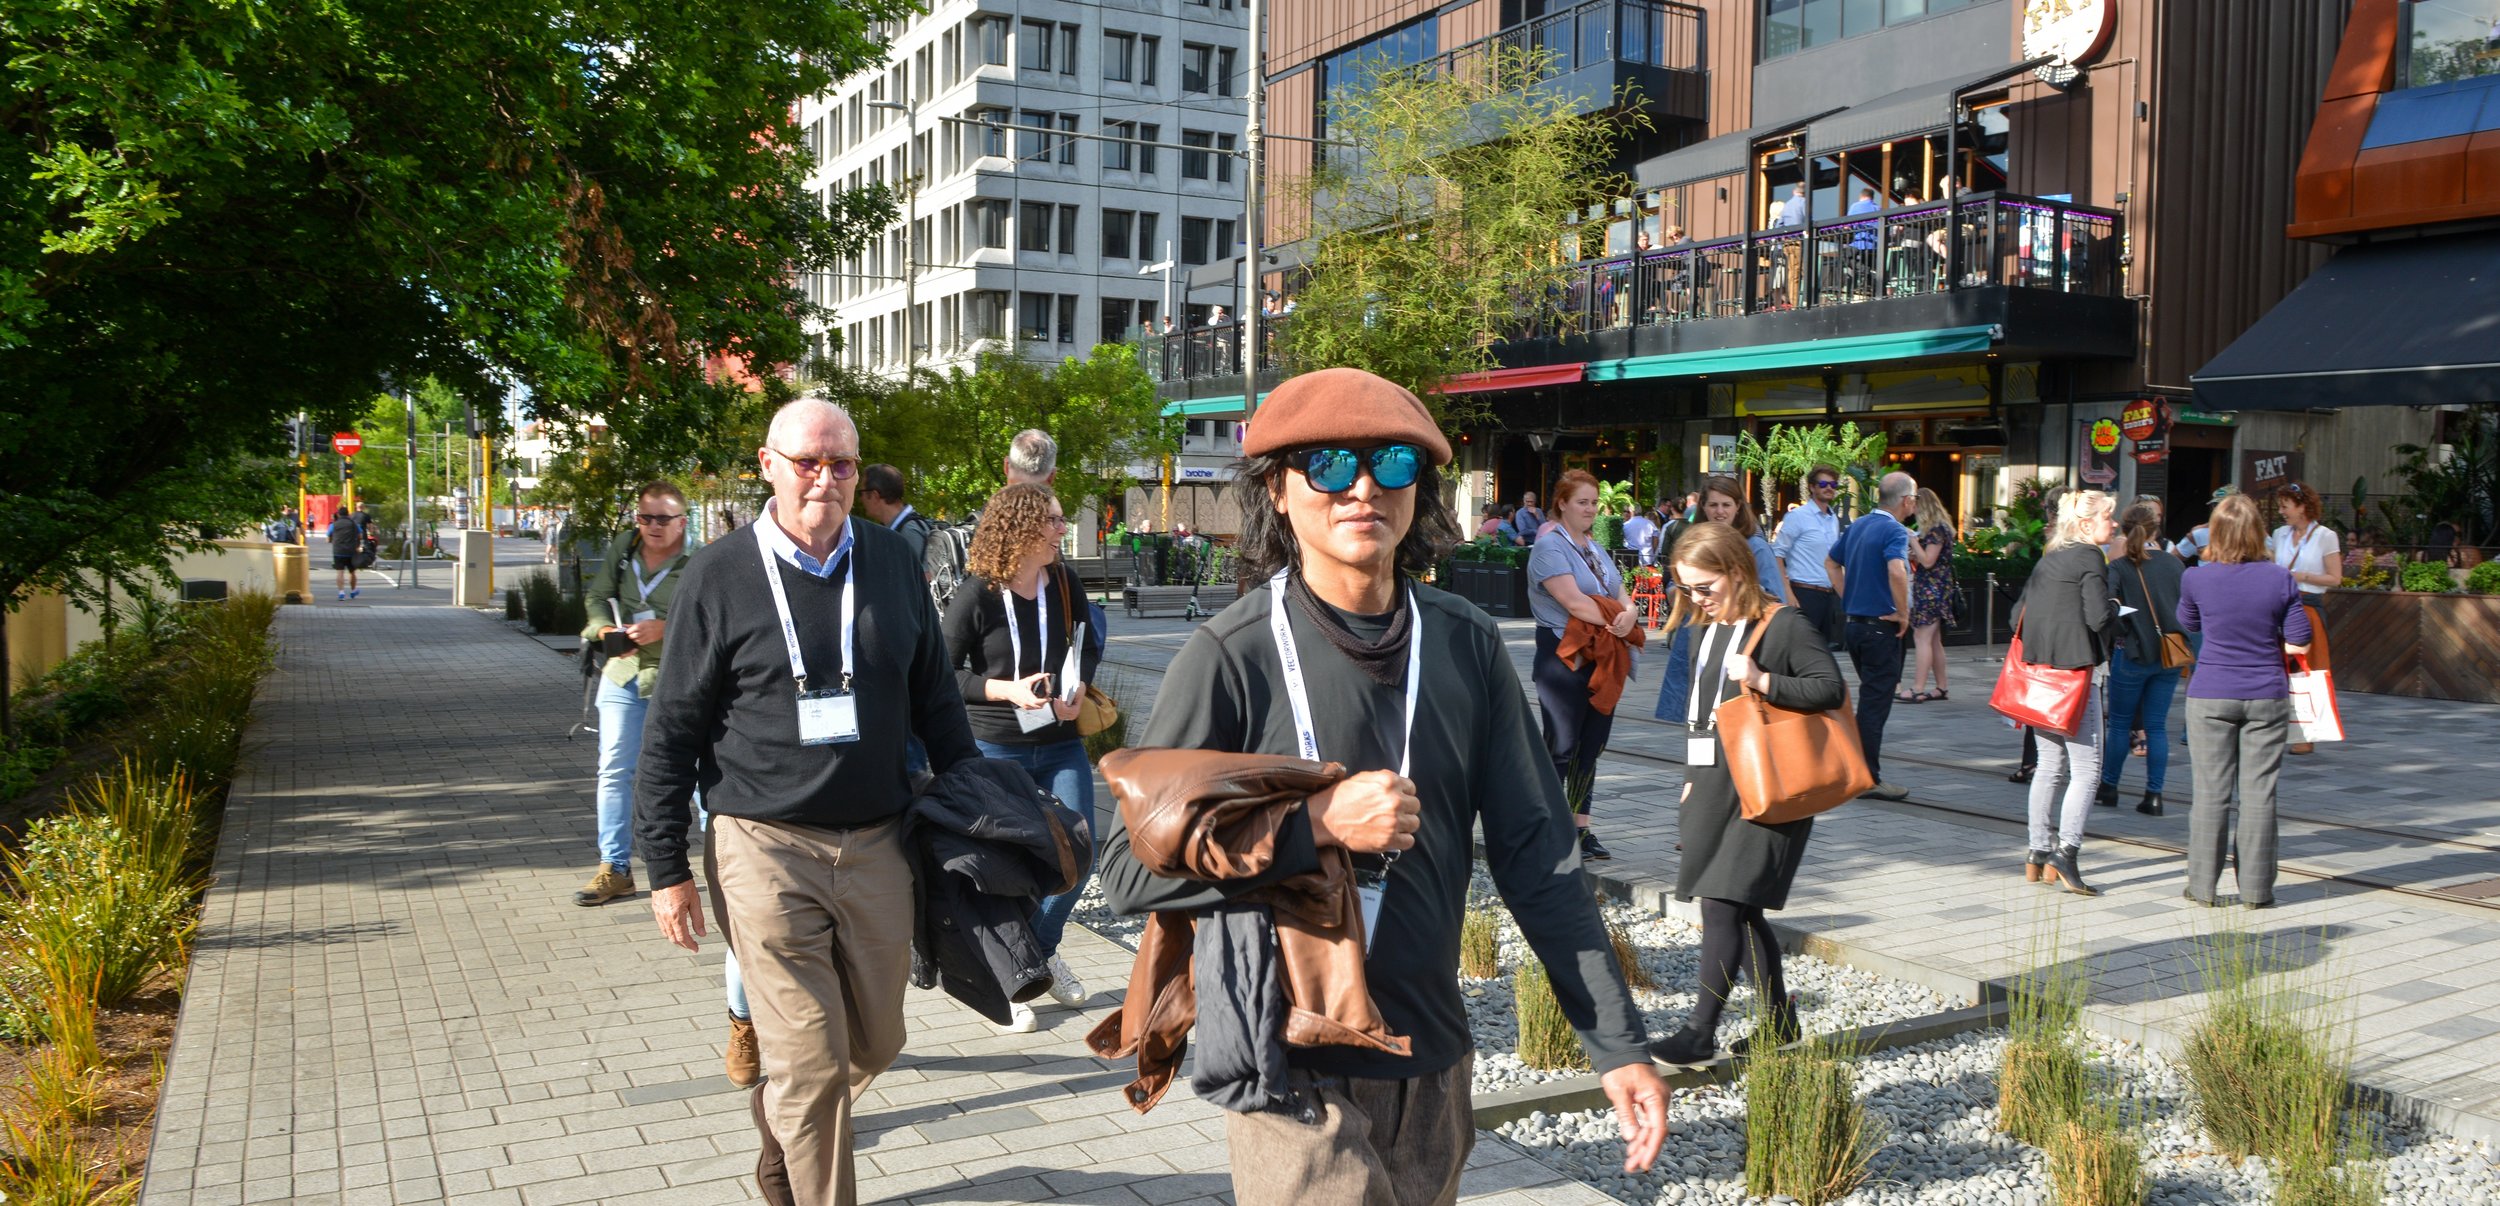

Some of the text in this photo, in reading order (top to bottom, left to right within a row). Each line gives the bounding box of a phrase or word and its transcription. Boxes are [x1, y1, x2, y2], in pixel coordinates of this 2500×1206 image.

[2024, 0, 2091, 34] FA
[2123, 407, 2152, 422] FAT
[1185, 469, 1214, 477] brother
[2254, 455, 2287, 482] FAT
[1277, 623, 1295, 672] VECTORWORKS
